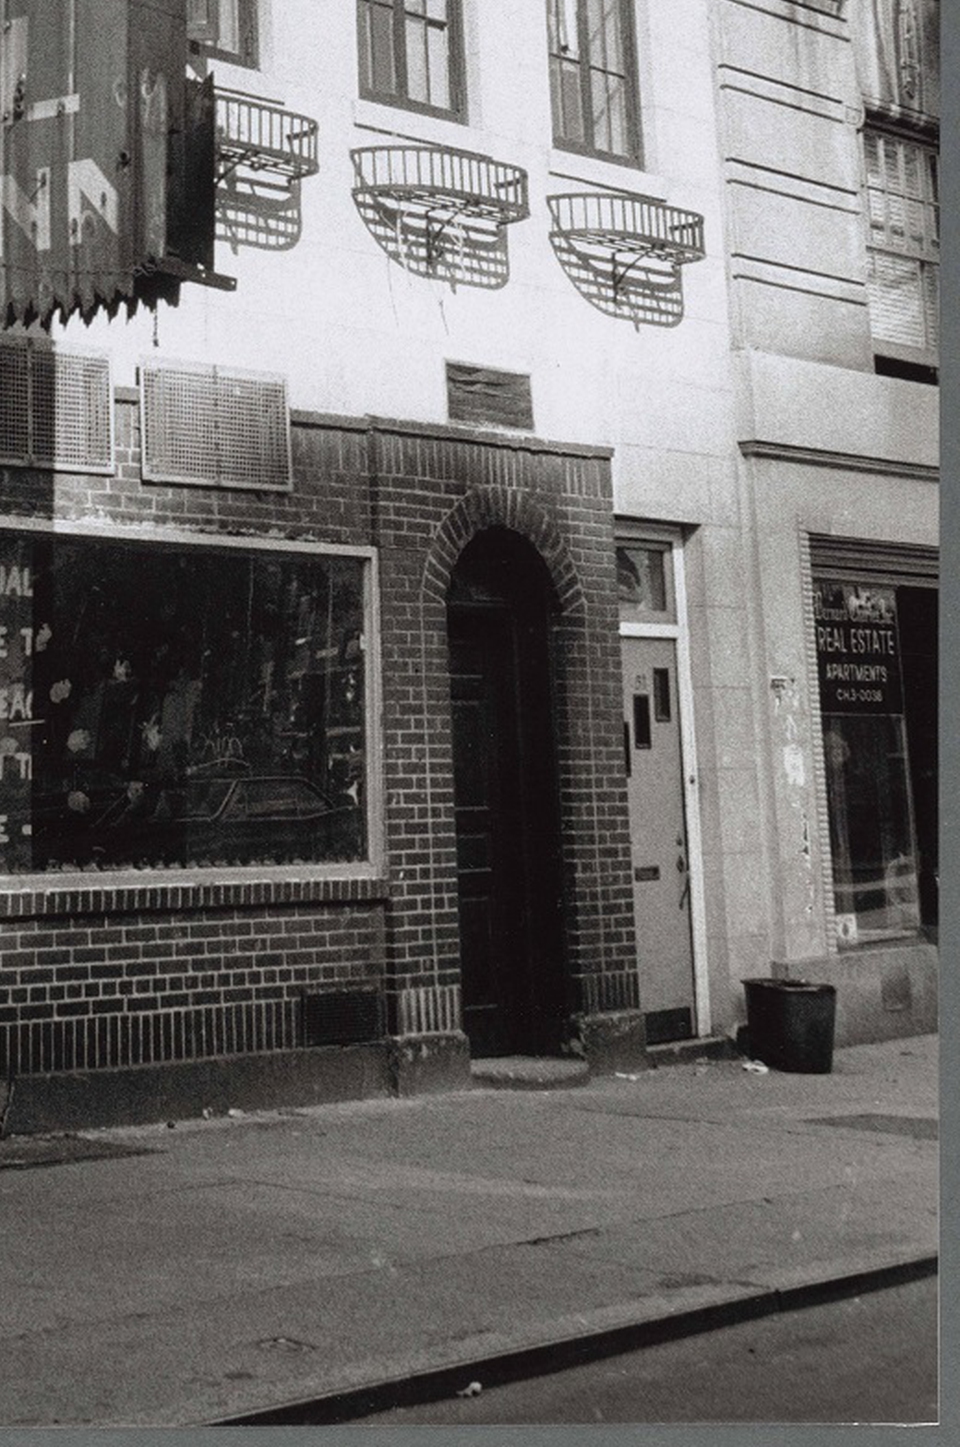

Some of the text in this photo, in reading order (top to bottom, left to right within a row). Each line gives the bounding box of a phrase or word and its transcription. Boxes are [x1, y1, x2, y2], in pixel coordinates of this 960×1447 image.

[817, 626, 895, 655] REAL ESTATE
[826, 662, 888, 684] APARTMENTS
